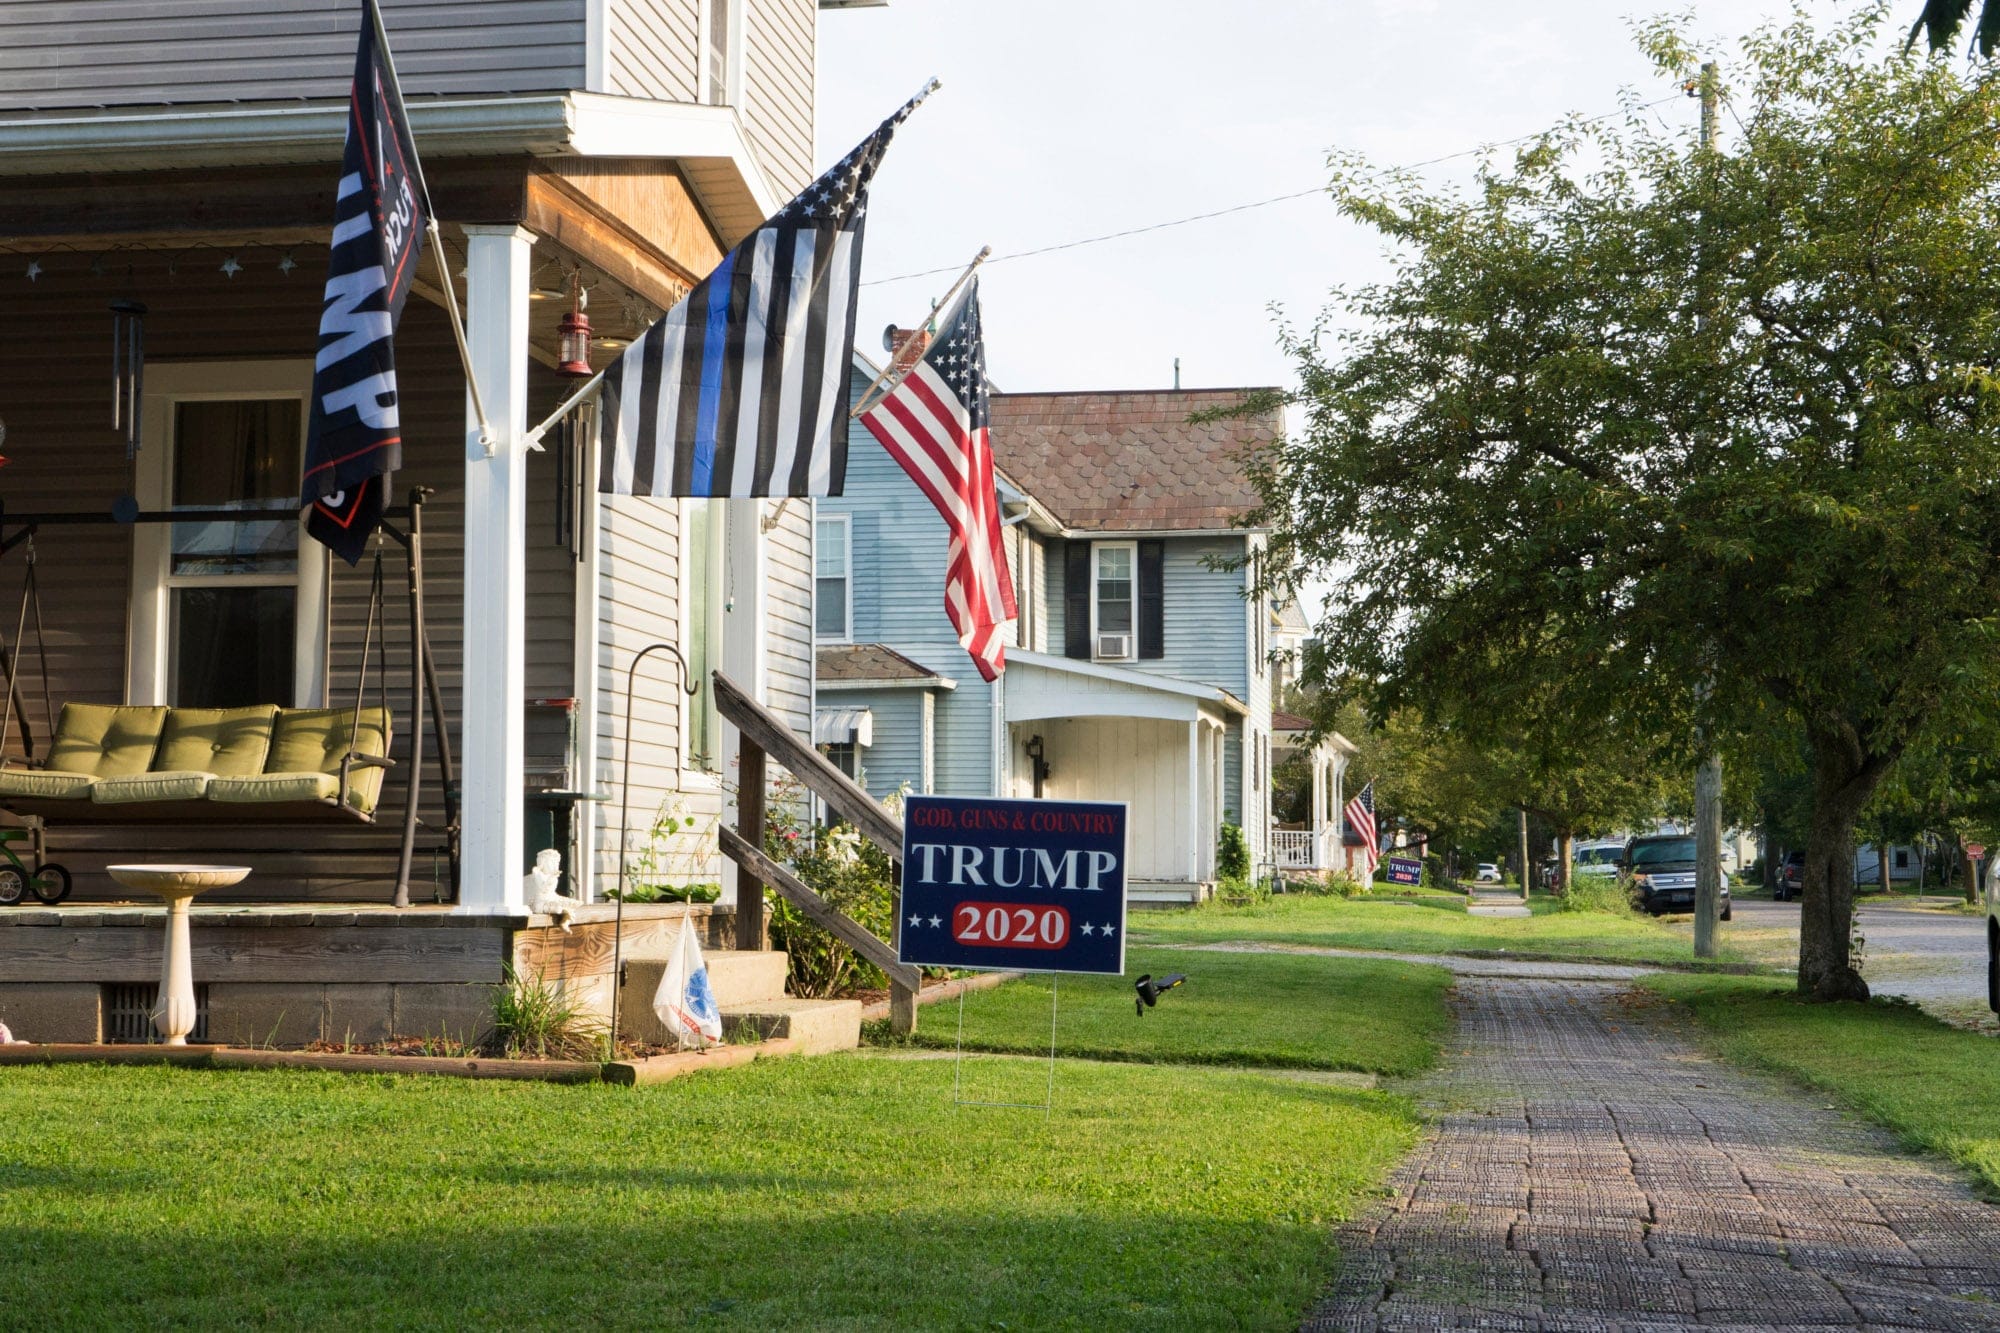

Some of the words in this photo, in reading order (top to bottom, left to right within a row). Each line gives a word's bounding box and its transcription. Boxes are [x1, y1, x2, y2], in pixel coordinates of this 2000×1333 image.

[913, 807, 956, 829] GOD,
[961, 808, 1008, 831] GUNS
[1012, 811, 1026, 831] &
[1030, 811, 1119, 834] COUNTRY
[911, 843, 1117, 891] TRUMP
[1390, 863, 1420, 874] TRUMP
[957, 906, 1065, 944] 2020
